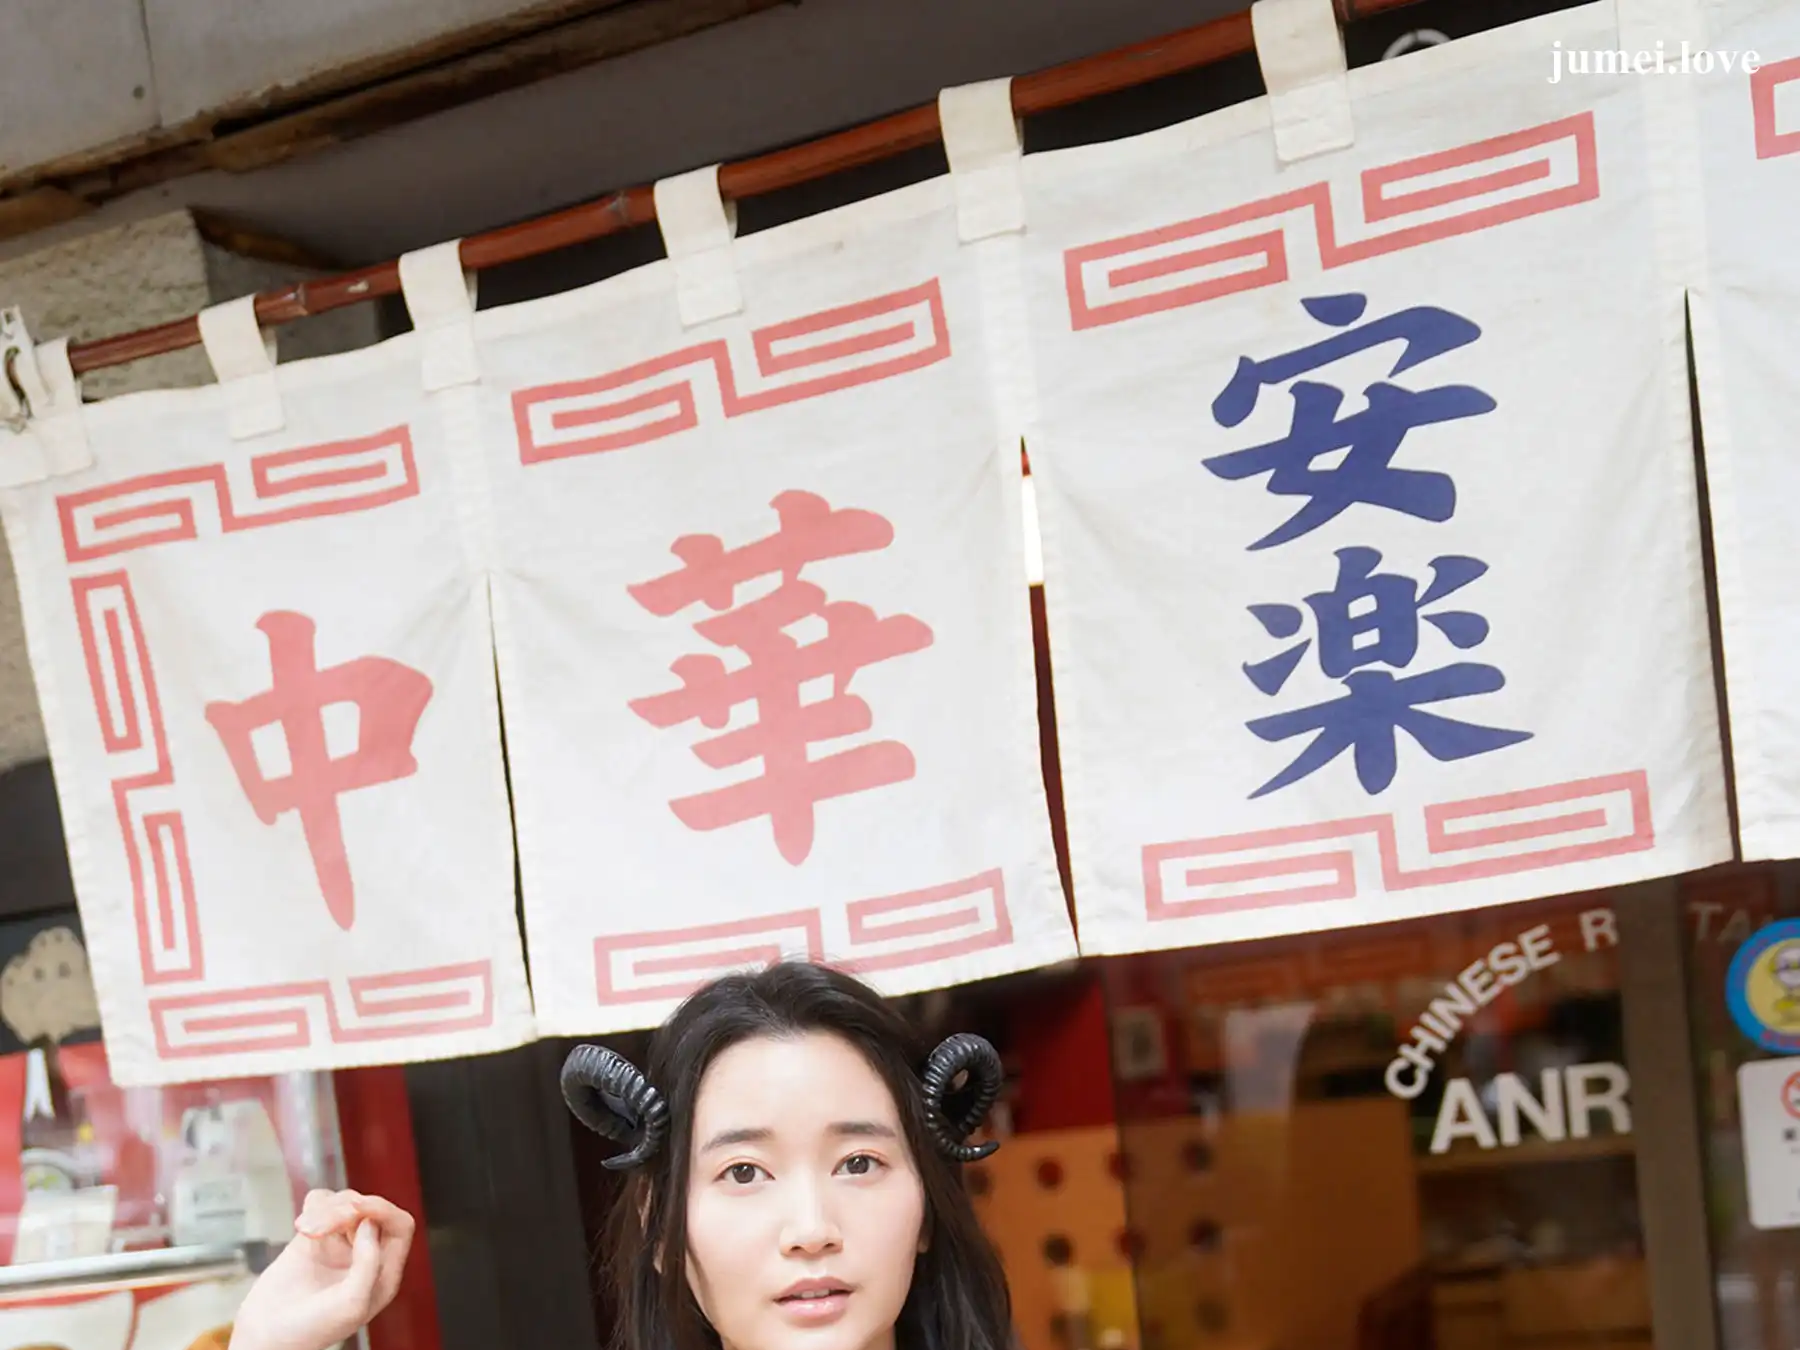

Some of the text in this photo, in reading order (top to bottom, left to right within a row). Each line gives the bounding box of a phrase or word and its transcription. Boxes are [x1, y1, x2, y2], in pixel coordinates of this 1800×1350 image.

[1201, 293, 1534, 800] 安楽
[1384, 924, 1562, 1099] CHINESE
[1430, 1061, 1633, 1154] ANR
